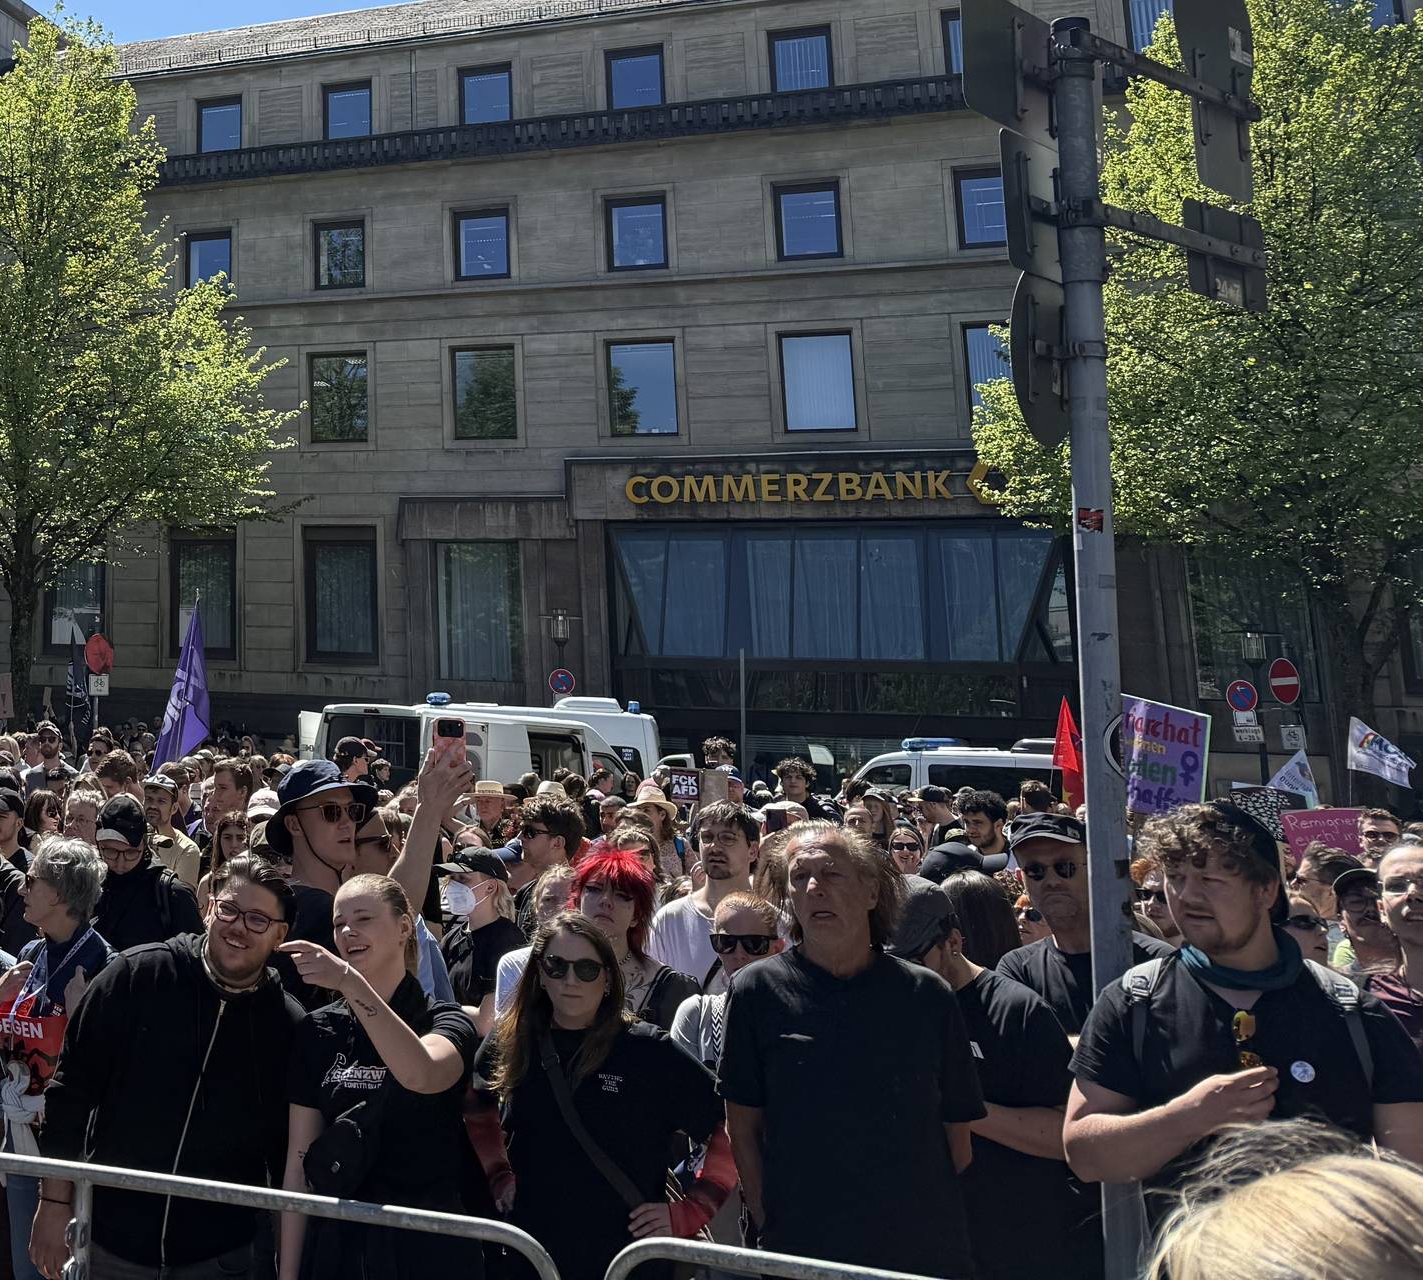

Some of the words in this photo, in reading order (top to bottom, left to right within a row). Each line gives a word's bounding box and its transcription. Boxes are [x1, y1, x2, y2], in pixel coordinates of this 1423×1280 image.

[626, 470, 954, 504] COMMERZBANK
[672, 774, 698, 786] FCK
[672, 785, 698, 796] AFD
[1285, 814, 1357, 834] Remigrier
